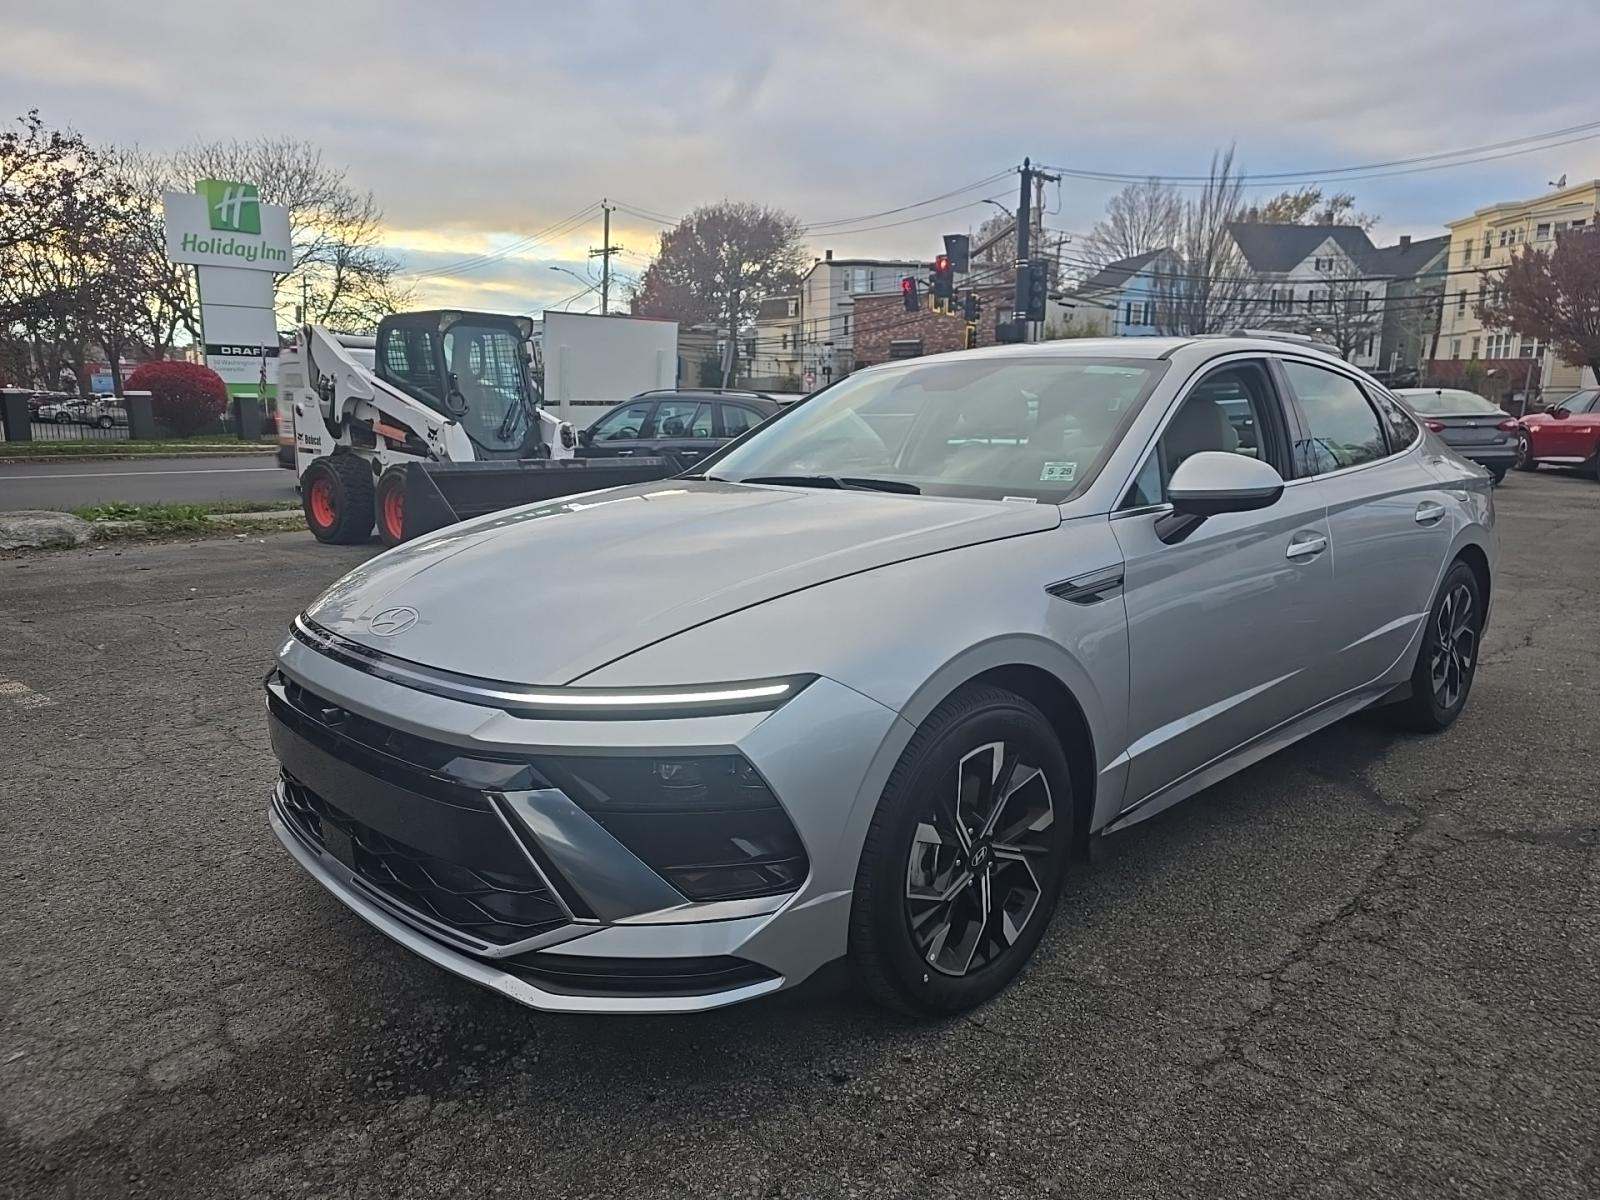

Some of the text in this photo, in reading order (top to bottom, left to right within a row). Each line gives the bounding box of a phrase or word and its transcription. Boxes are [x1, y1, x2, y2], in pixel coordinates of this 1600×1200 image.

[180, 233, 287, 262] Holiday Inn
[1060, 467, 1072, 475] 29
